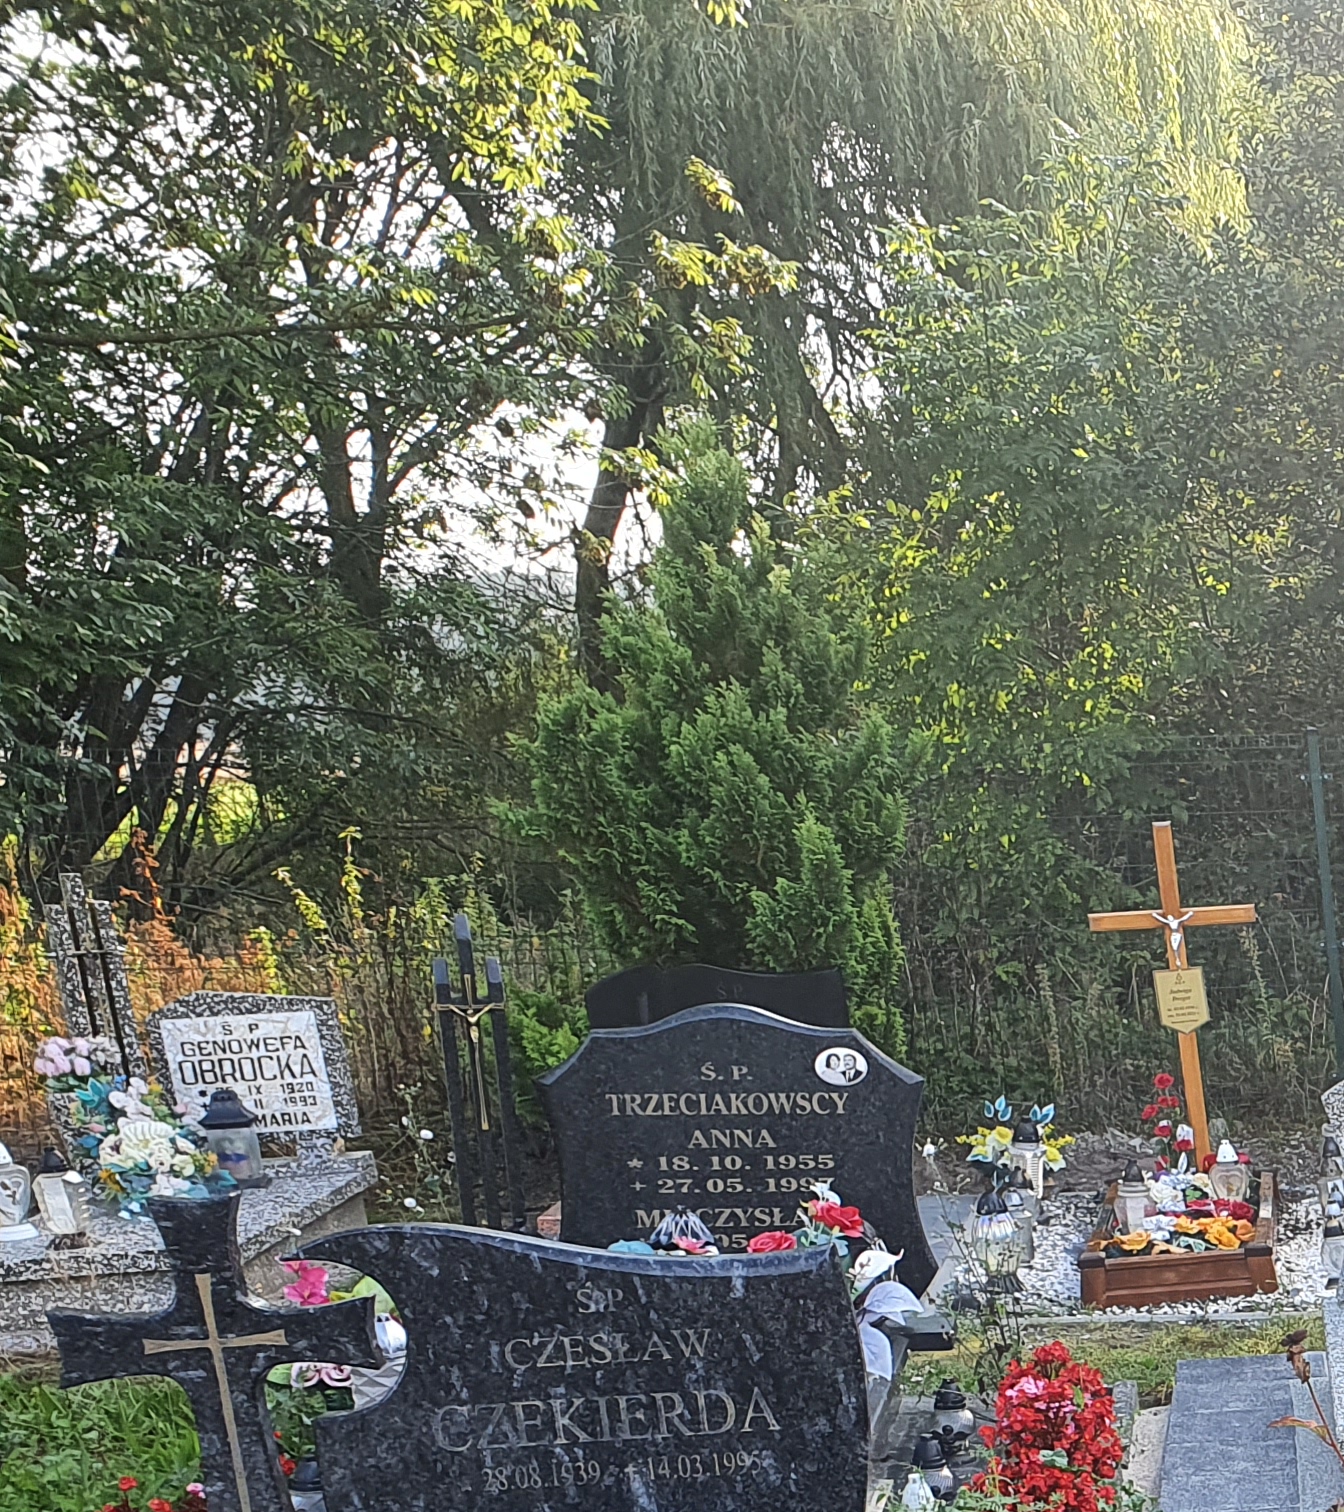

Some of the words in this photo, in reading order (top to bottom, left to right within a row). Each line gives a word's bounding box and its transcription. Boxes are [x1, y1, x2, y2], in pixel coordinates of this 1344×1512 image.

[180, 1034, 309, 1057] GENOWEFA
[178, 1053, 318, 1086] OBROCKA
[280, 1081, 315, 1093] 1920
[282, 1095, 318, 1107] 1993
[605, 1092, 849, 1117] TRZECIAKOWSCY
[254, 1111, 313, 1129] MARIA
[688, 1129, 777, 1149] ANNA
[763, 1154, 836, 1170] 1955
[504, 1328, 711, 1369] CZESŁAW
[434, 1386, 782, 1452] CZEKIERDA
